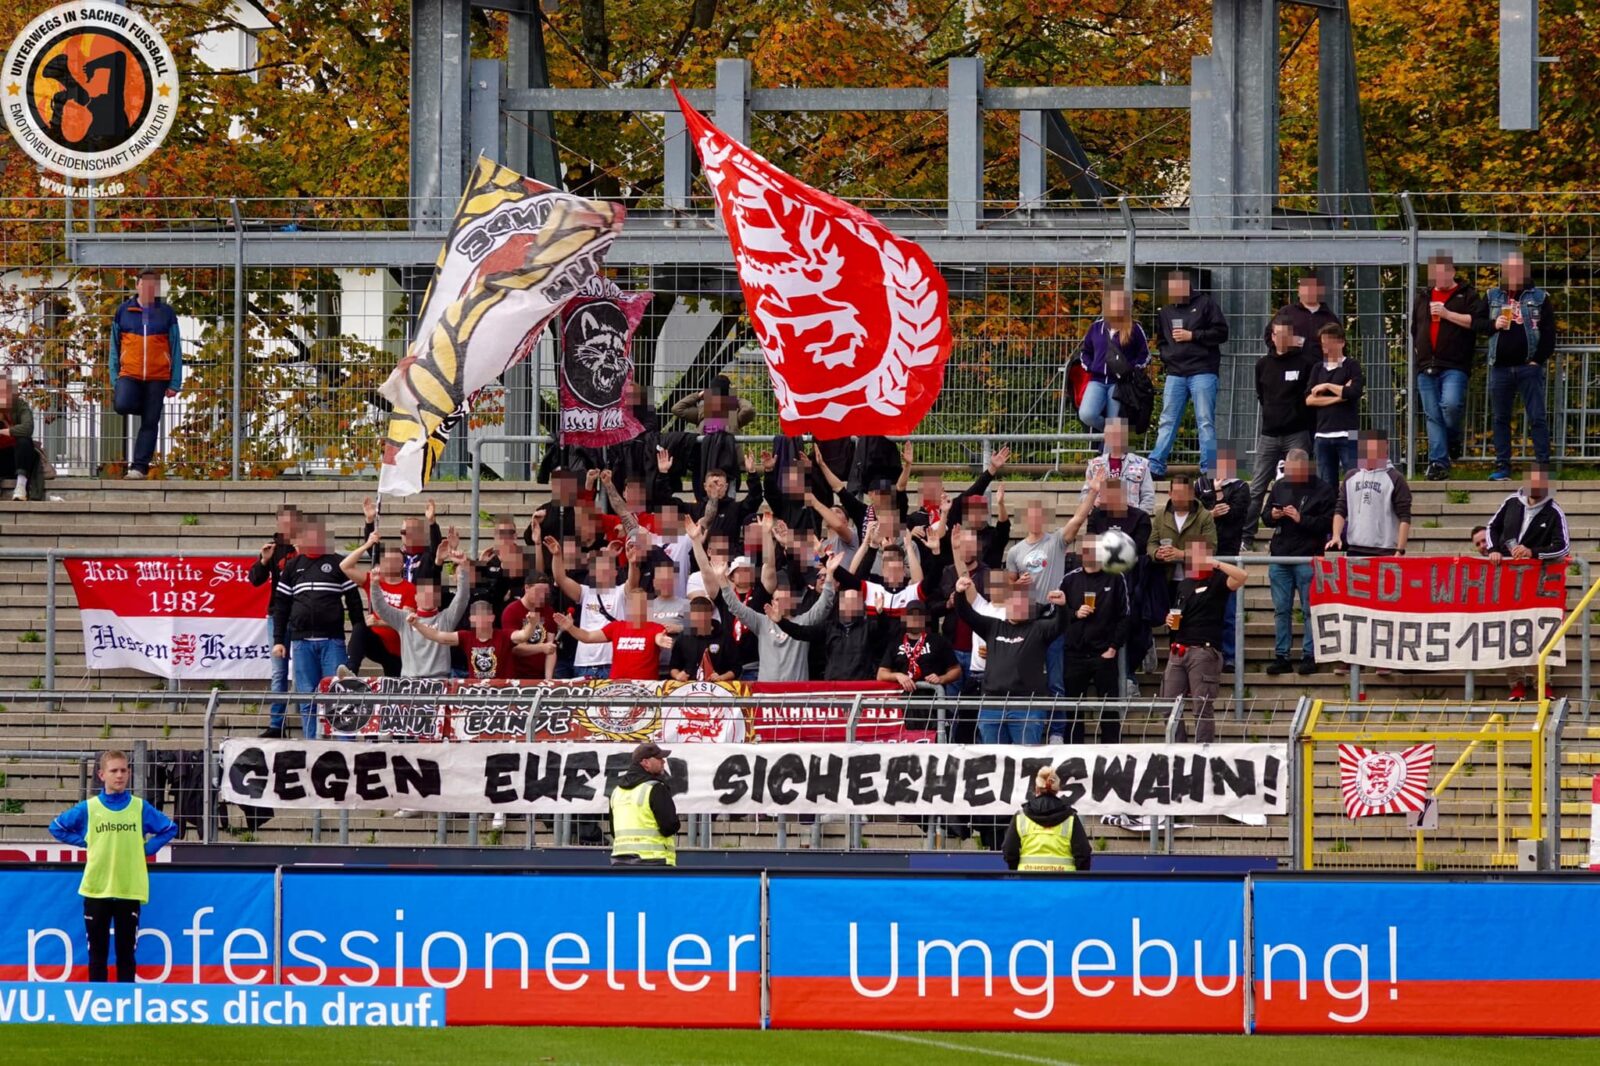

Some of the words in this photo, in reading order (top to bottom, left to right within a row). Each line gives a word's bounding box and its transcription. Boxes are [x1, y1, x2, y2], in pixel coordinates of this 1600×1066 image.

[82, 560, 129, 588] Red
[136, 560, 203, 587] White
[148, 591, 215, 613] 1982
[691, 682, 717, 694] KSV
[228, 747, 441, 802] GEGEN
[713, 752, 1281, 807] SICHERHEITSWAHN!
[96, 821, 137, 834] uhlsport
[27, 906, 756, 992] pofessioneller
[849, 917, 1399, 1024] Umgebung!
[64, 988, 209, 1024] Verlass
[223, 990, 307, 1025] dich
[321, 992, 440, 1027] drauf.
